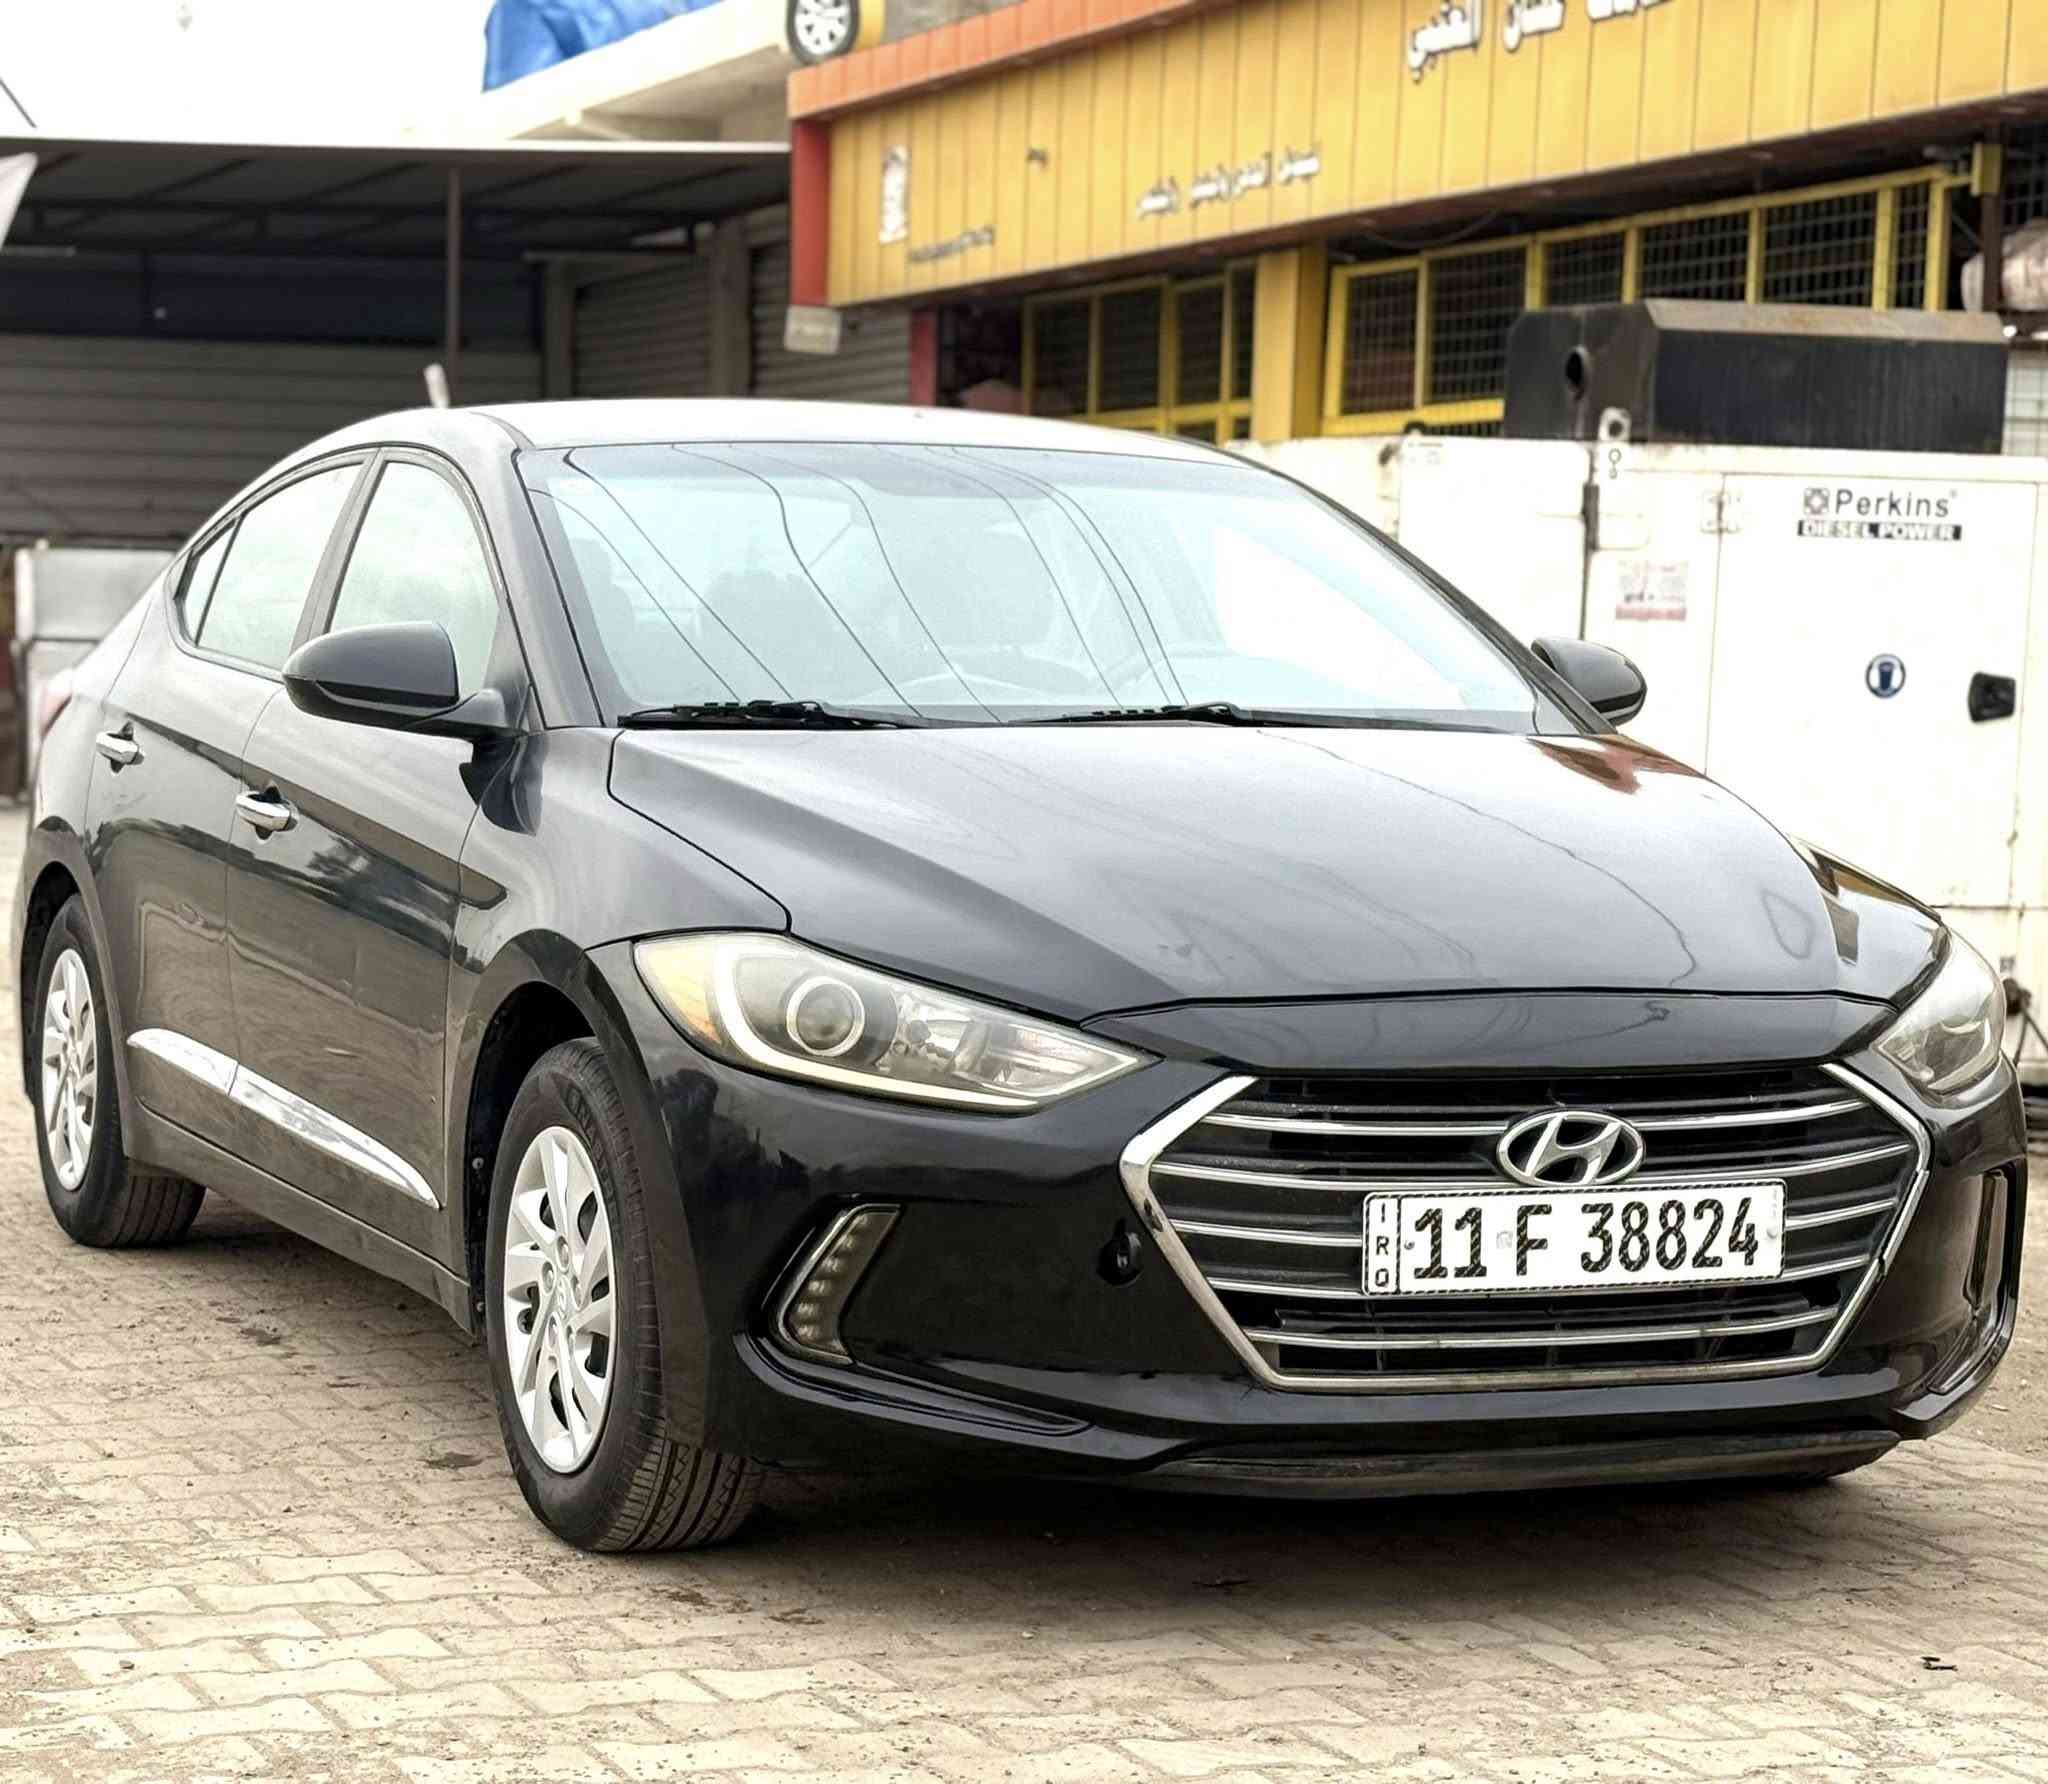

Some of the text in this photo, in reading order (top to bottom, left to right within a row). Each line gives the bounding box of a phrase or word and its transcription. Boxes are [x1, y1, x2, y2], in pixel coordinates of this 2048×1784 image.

[1836, 488, 1950, 517] Perkins
[1804, 521, 1953, 540] DIESEL POWER
[1414, 1197, 1759, 1279] 11 F 38824
